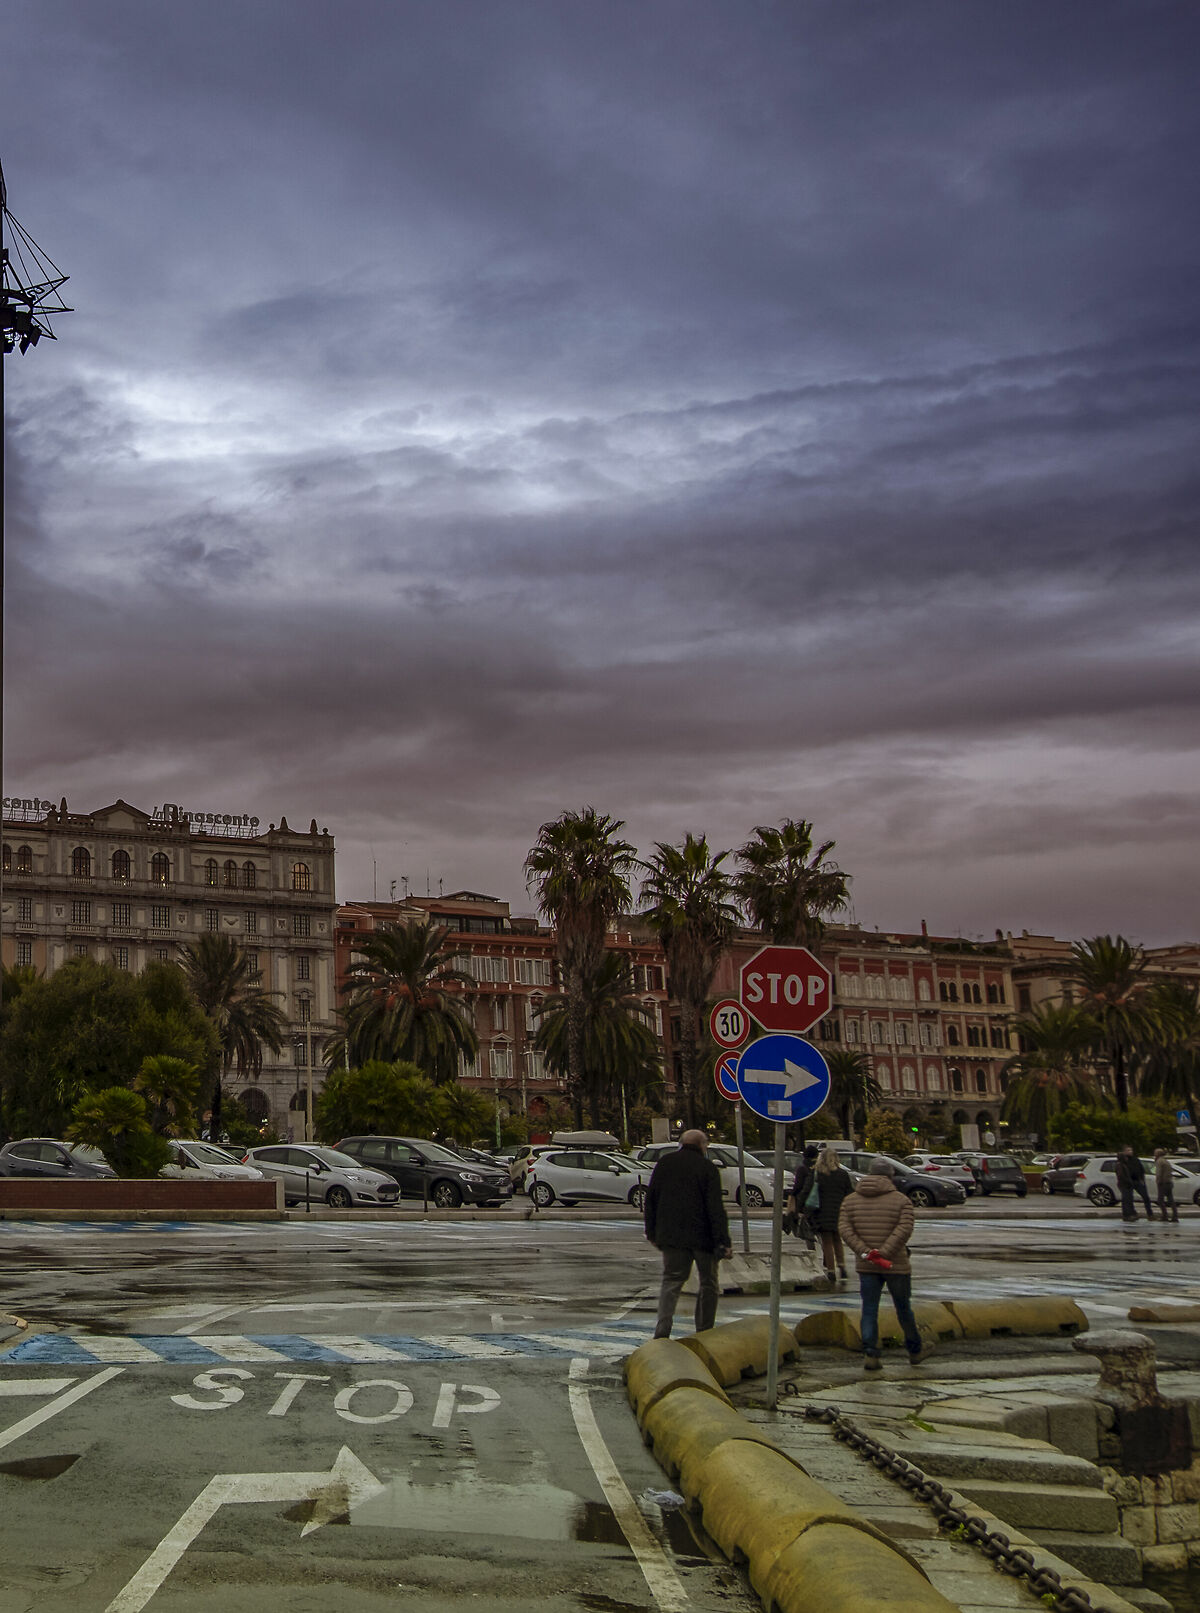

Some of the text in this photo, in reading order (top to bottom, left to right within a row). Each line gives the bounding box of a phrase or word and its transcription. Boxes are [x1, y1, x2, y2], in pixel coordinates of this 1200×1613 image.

[163, 804, 259, 827] Rinascente
[746, 972, 825, 1006] STOP
[720, 1012, 740, 1037] 30
[170, 1367, 502, 1428] STOP
